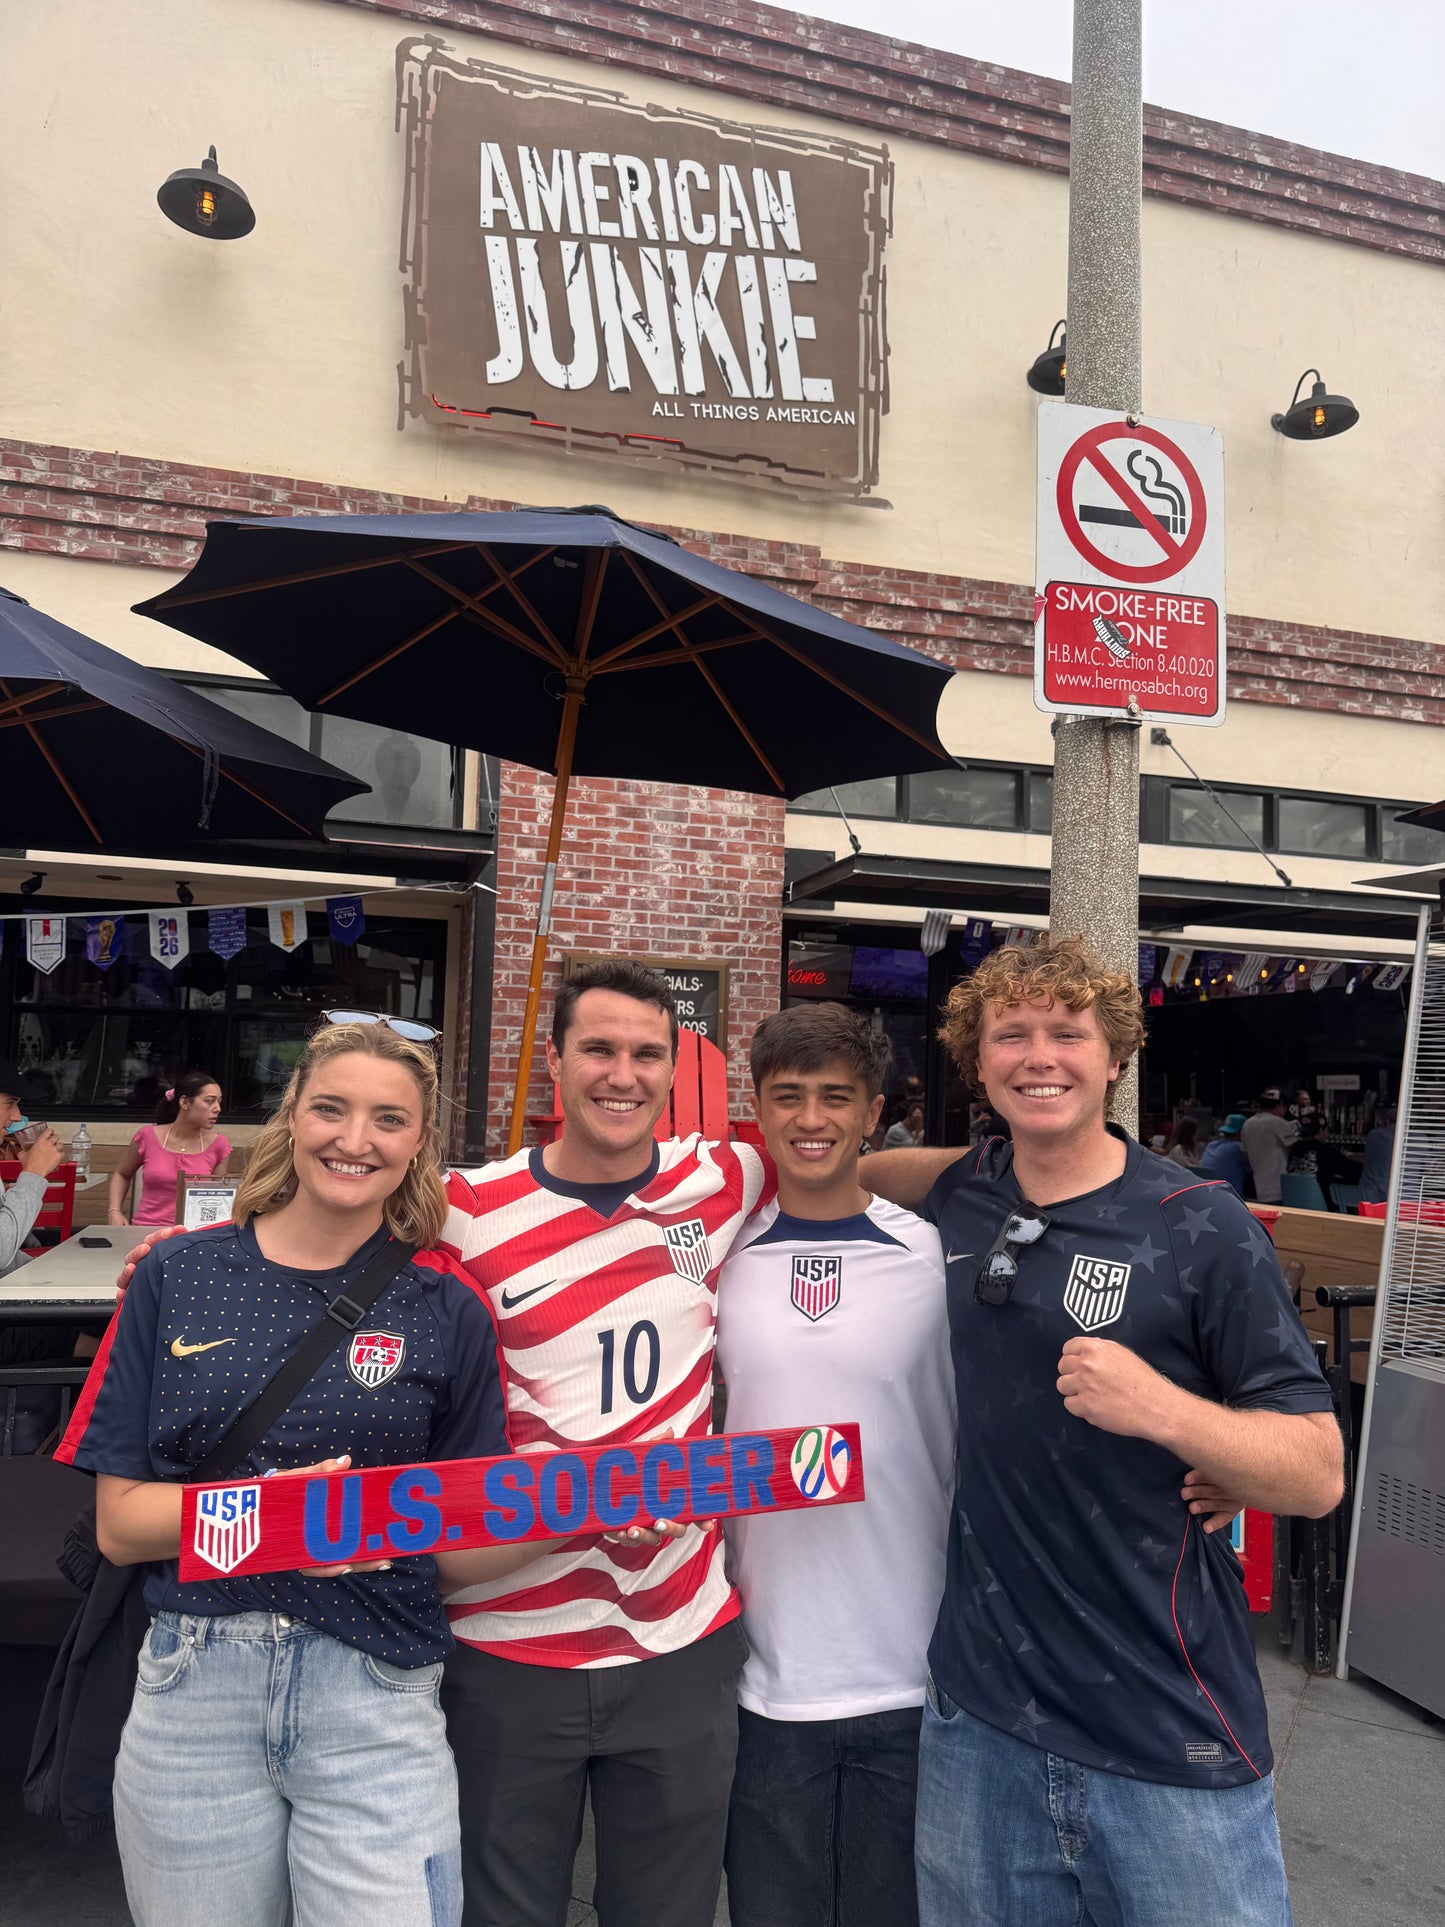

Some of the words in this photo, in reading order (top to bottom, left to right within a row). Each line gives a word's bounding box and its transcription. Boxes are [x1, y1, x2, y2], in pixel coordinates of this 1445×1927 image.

[479, 141, 802, 253] AMERICAN
[484, 235, 835, 403] JUNKIE
[652, 401, 684, 418] ALL
[690, 403, 760, 421] THINGS
[766, 407, 856, 426] AMERICAN
[1055, 586, 1206, 626] SMOKE-FREE
[1095, 621, 1168, 649] ONE
[1048, 642, 1104, 667] H.B.M.C.
[1157, 653, 1215, 678] 8.40.020
[1055, 669, 1208, 704] www.hermosabch.org
[158, 918, 177, 937] 20
[160, 936, 179, 957] 26
[666, 1221, 704, 1248] USA
[796, 1259, 837, 1282] USA
[1077, 1262, 1125, 1290] USA
[355, 1348, 397, 1366] US
[597, 1319, 660, 1415] 10
[202, 1489, 256, 1523] USA
[304, 1468, 462, 1563] U.S.
[484, 1435, 776, 1540] SOCCER
